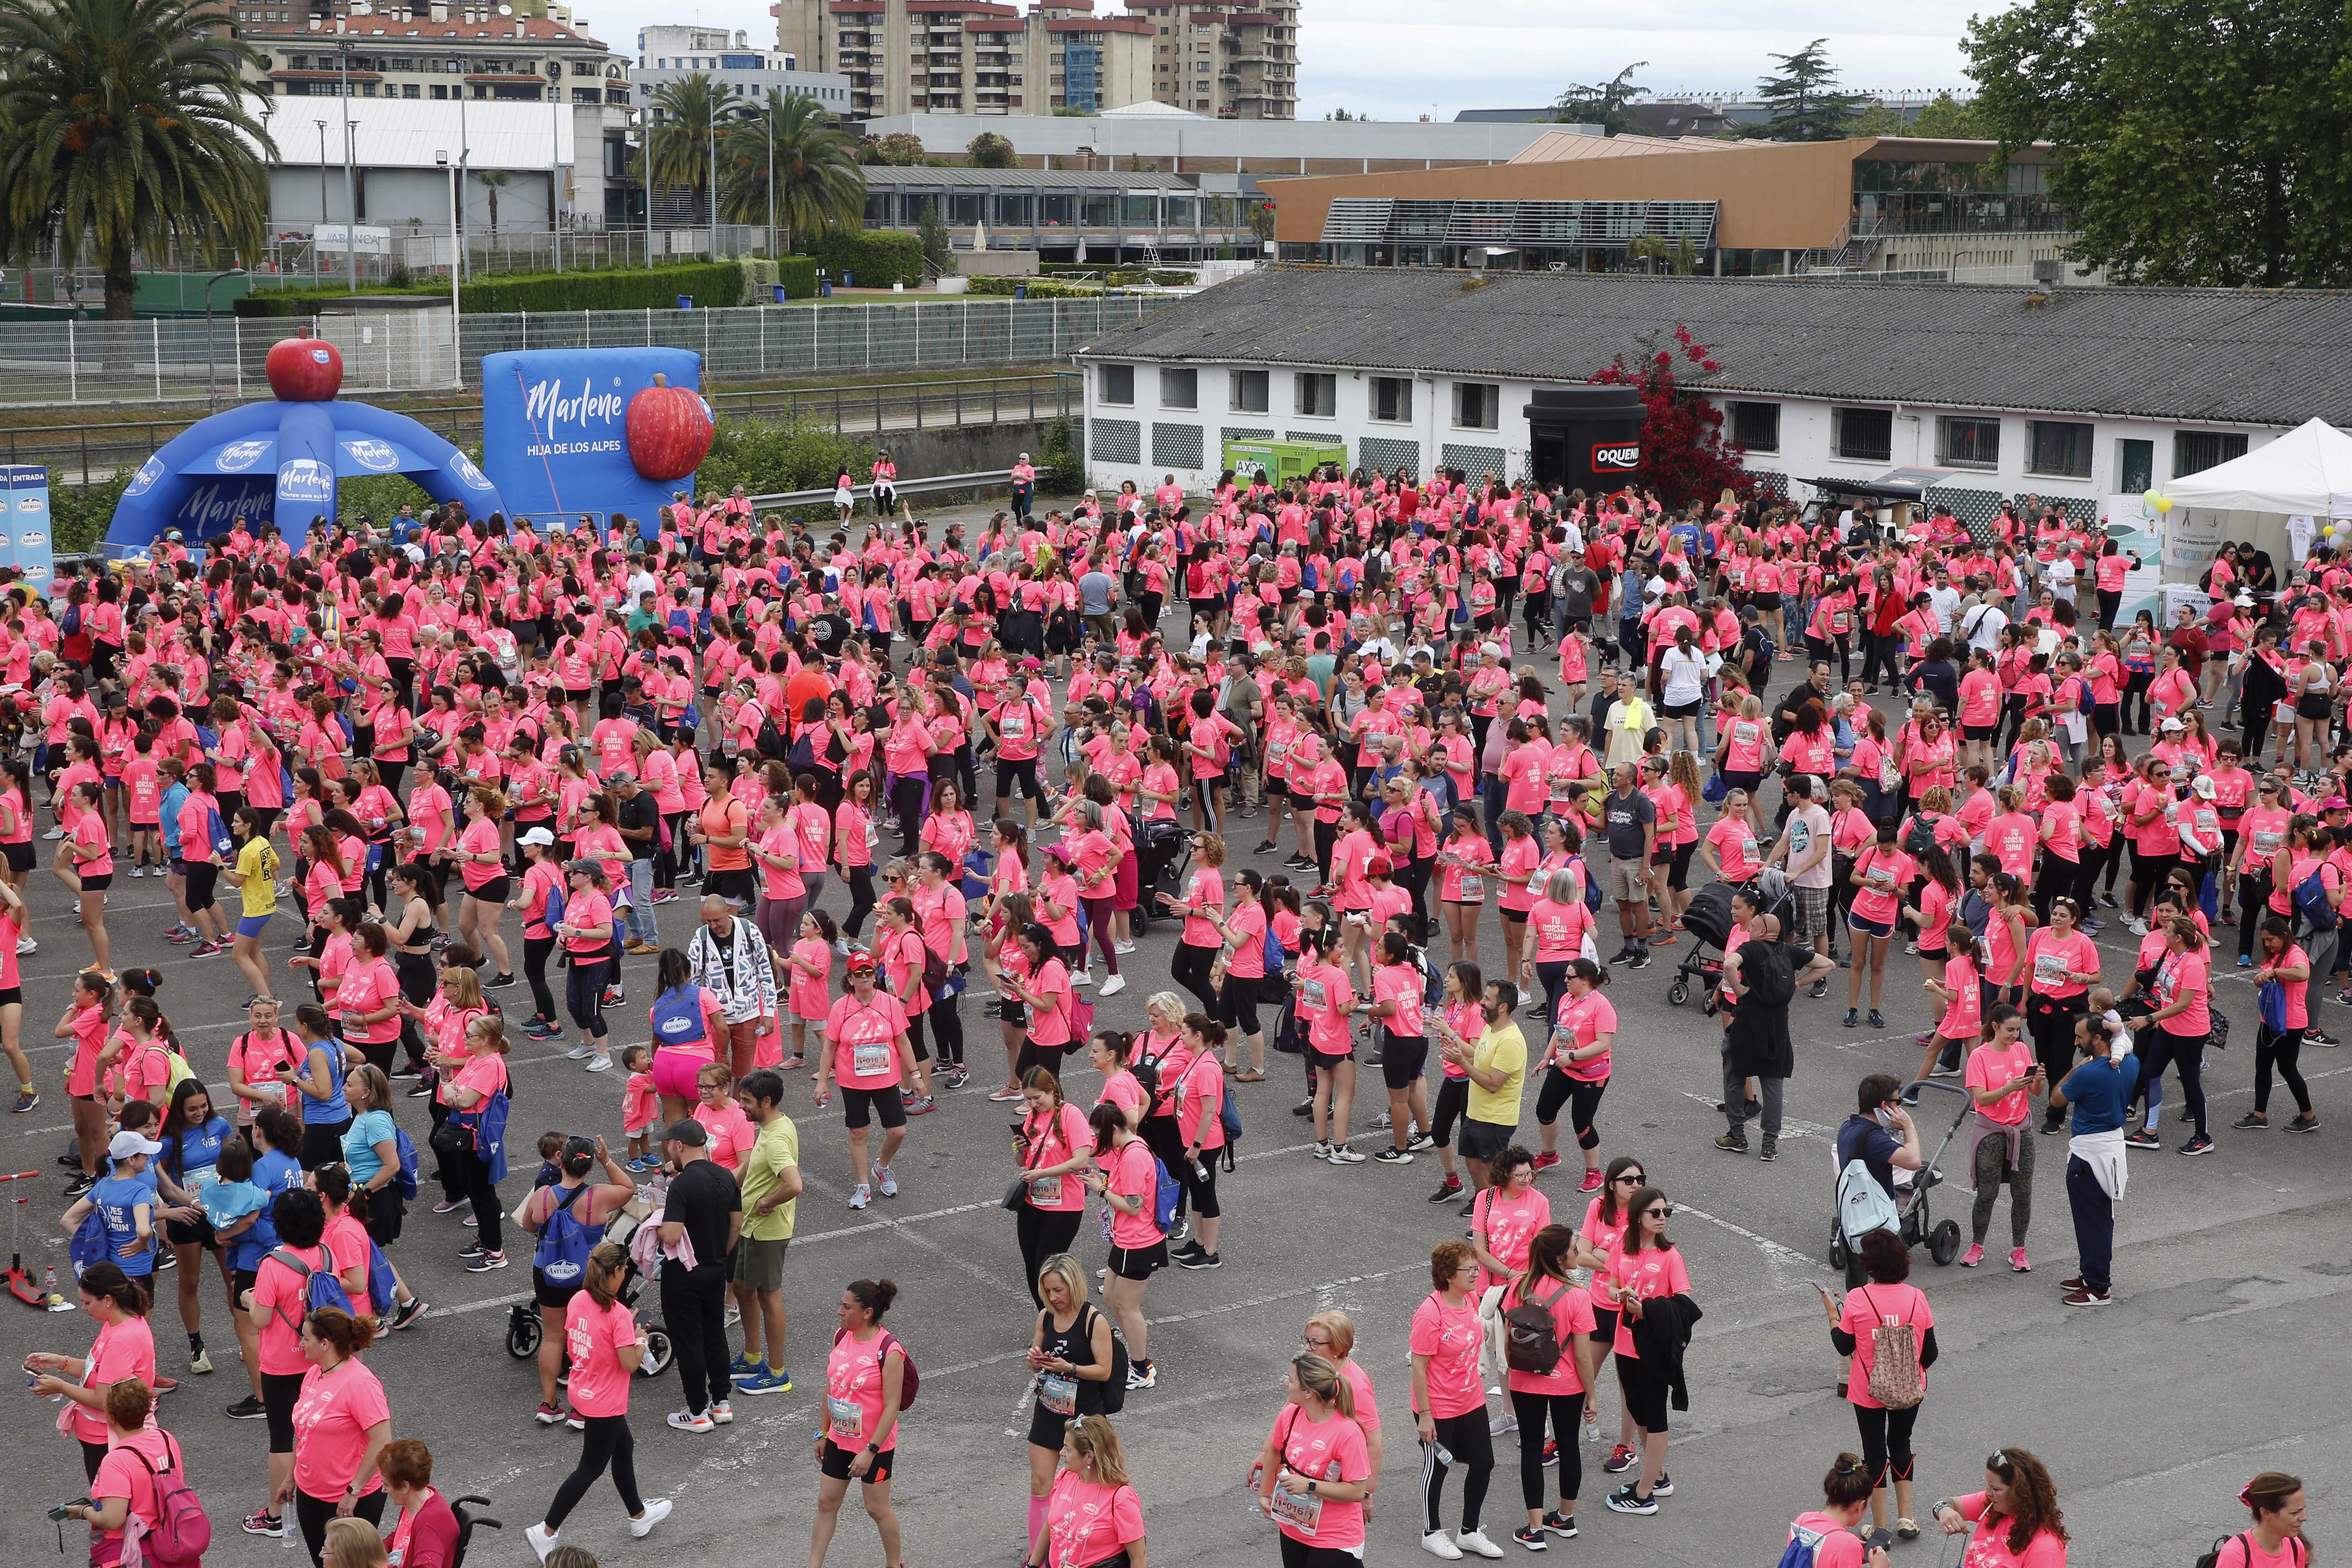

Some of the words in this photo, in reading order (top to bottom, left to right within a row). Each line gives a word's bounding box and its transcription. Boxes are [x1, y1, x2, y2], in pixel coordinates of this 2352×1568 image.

[527, 377, 622, 440] Marlene
[222, 446, 261, 462] Marlene
[351, 445, 392, 462] Marlene
[527, 444, 552, 456] HIJA
[554, 443, 569, 455] DE
[570, 442, 590, 453] LOS
[592, 440, 621, 452] ALPES
[280, 468, 331, 491] Marlene
[178, 481, 273, 537] Marlene
[1551, 916, 1560, 925] TU
[1542, 924, 1568, 933] DORSAL
[1402, 981, 1411, 990] TU
[1398, 989, 1418, 1001] DORSAL
[1401, 1000, 1417, 1010] SUMA
[664, 1022, 690, 1031] ASTURIANA
[110, 1206, 123, 1215] YES
[111, 1215, 123, 1224] WE
[111, 1223, 129, 1232] RUN
[548, 1265, 579, 1275] ASTURIANA
[578, 1317, 587, 1331] TU
[1884, 1314, 1899, 1327] TU
[834, 1417, 847, 1427] 016
[156, 1454, 169, 1470] TU
[1286, 1503, 1303, 1515] 016
